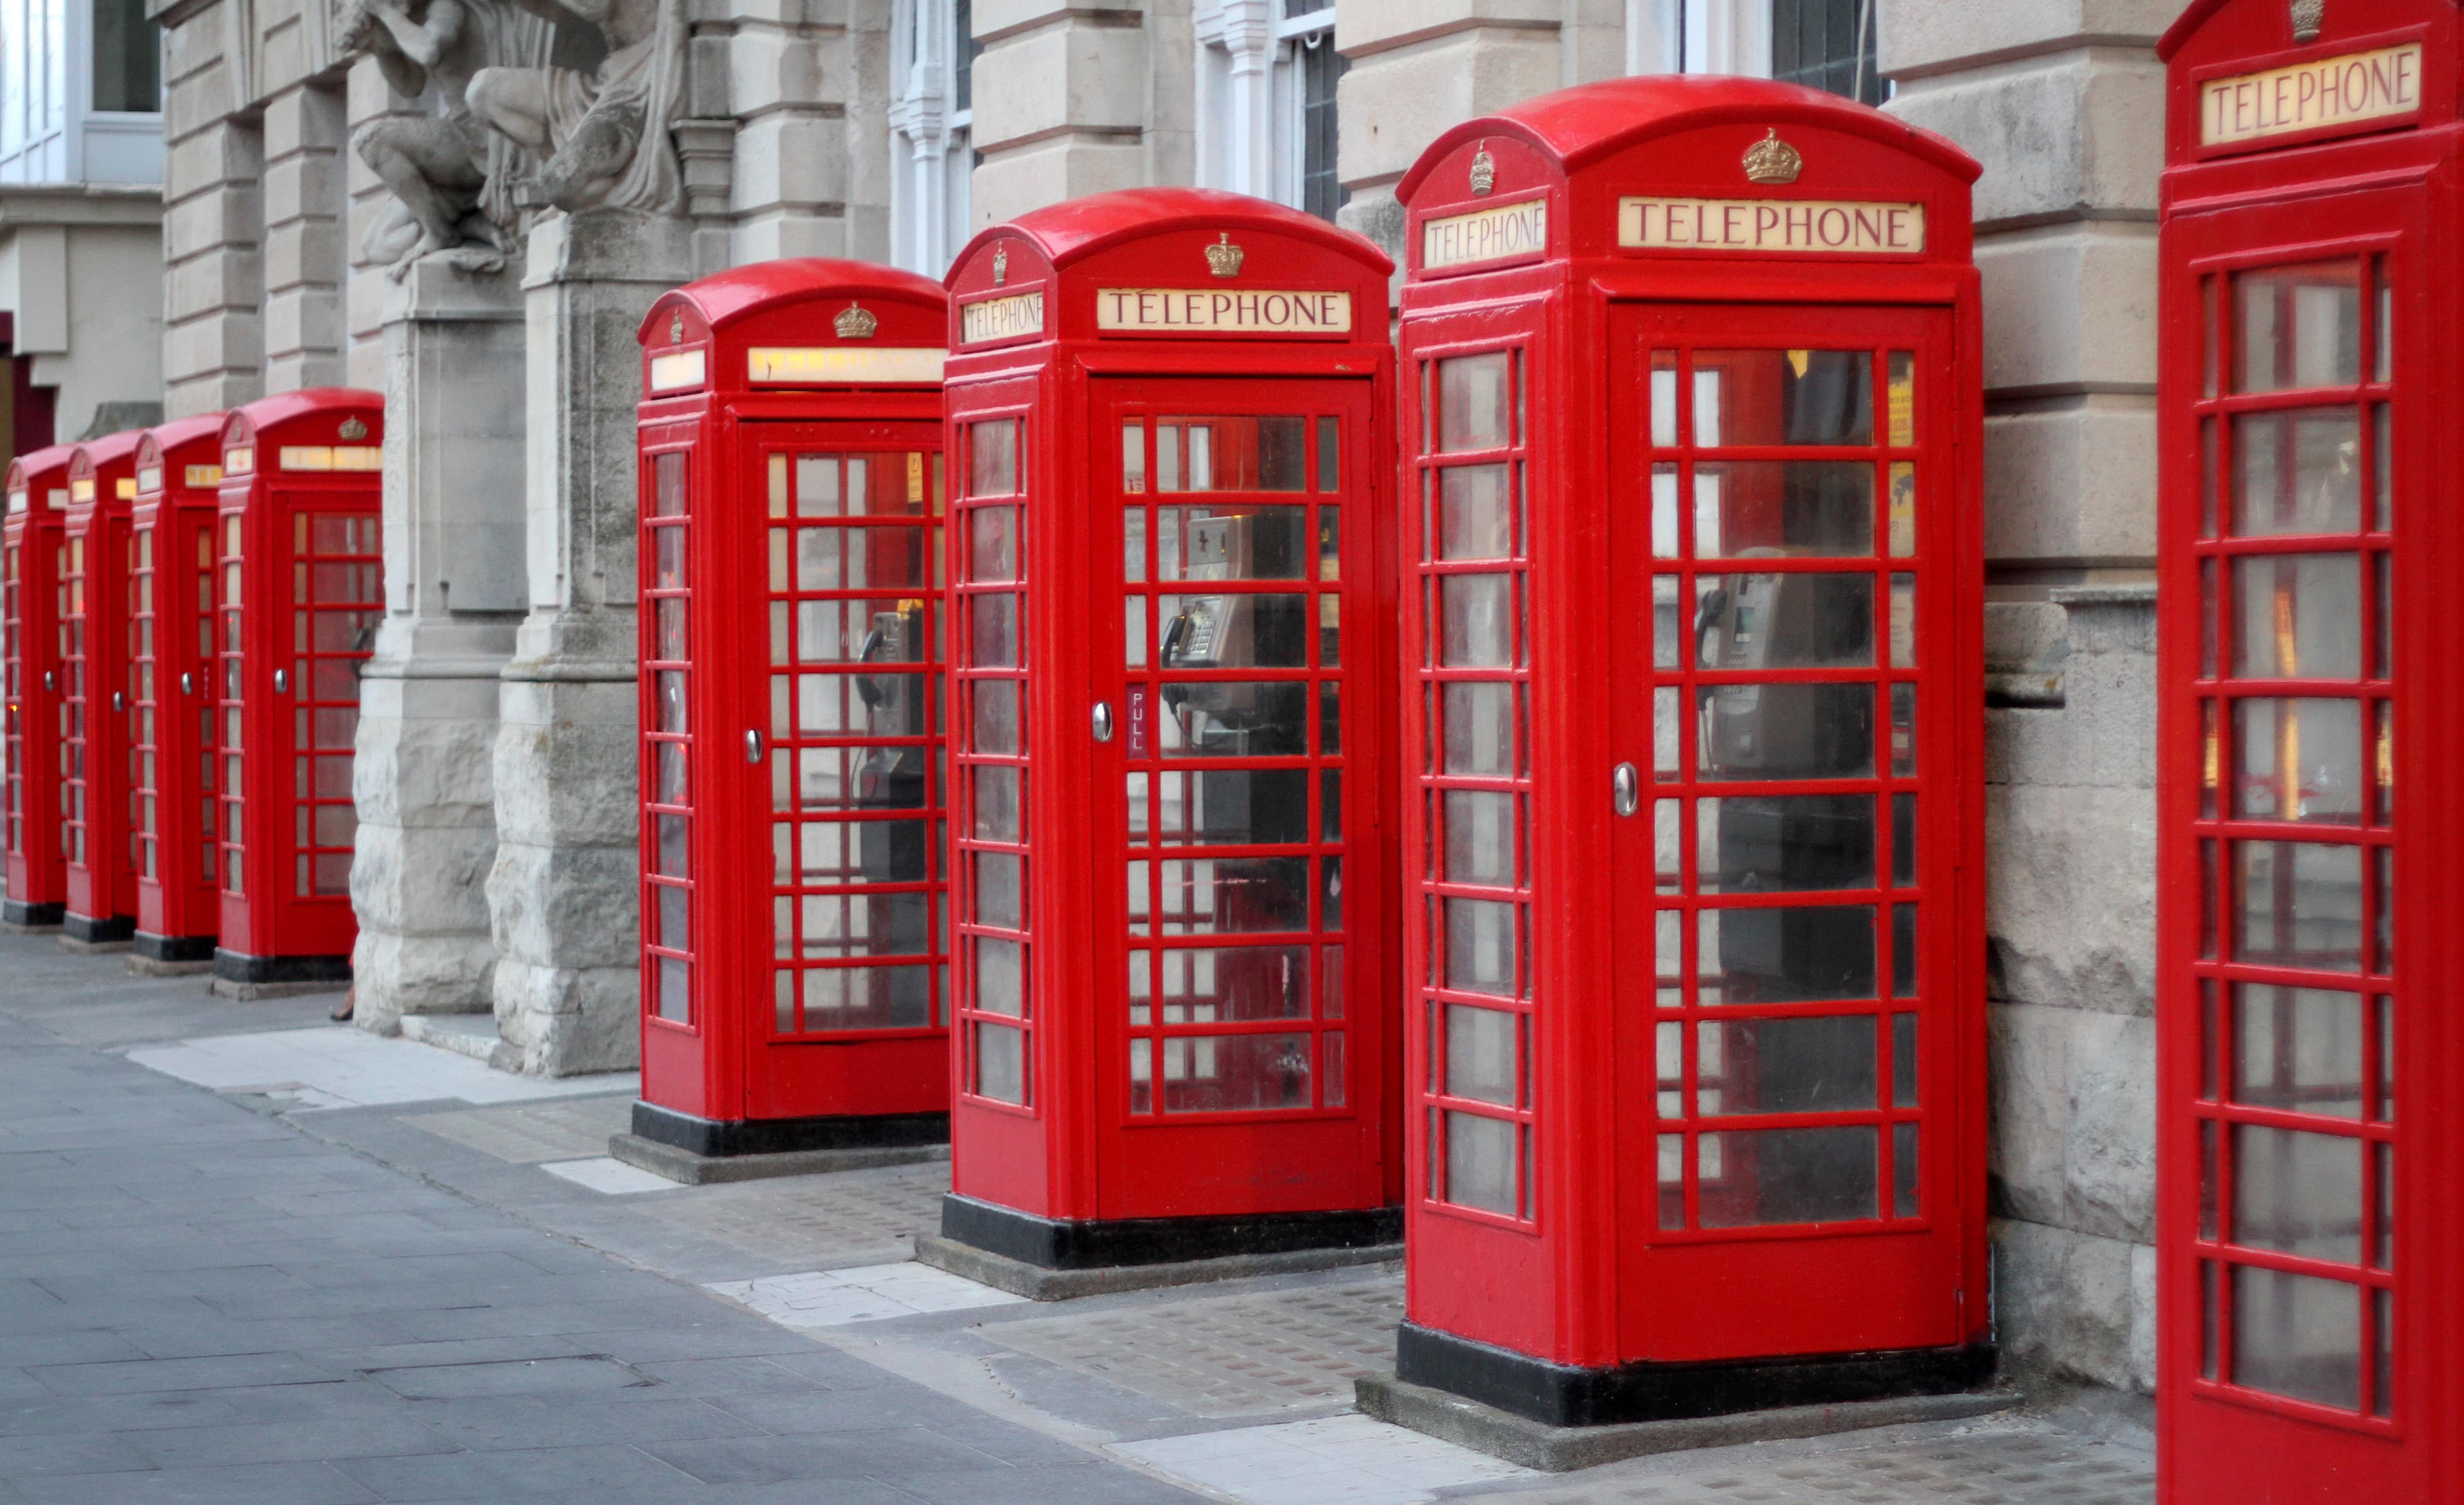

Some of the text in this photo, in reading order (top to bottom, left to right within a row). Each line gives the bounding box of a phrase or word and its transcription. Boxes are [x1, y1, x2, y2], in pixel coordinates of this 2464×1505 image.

[2211, 51, 2414, 135] TELEPHONE
[1429, 207, 1544, 264] TELEPHONE
[1630, 202, 1910, 247] TELEPHONE
[966, 296, 1043, 338] TELEPHONE
[1108, 292, 1339, 325] TELEPHONE
[1133, 692, 1142, 749] PULL
